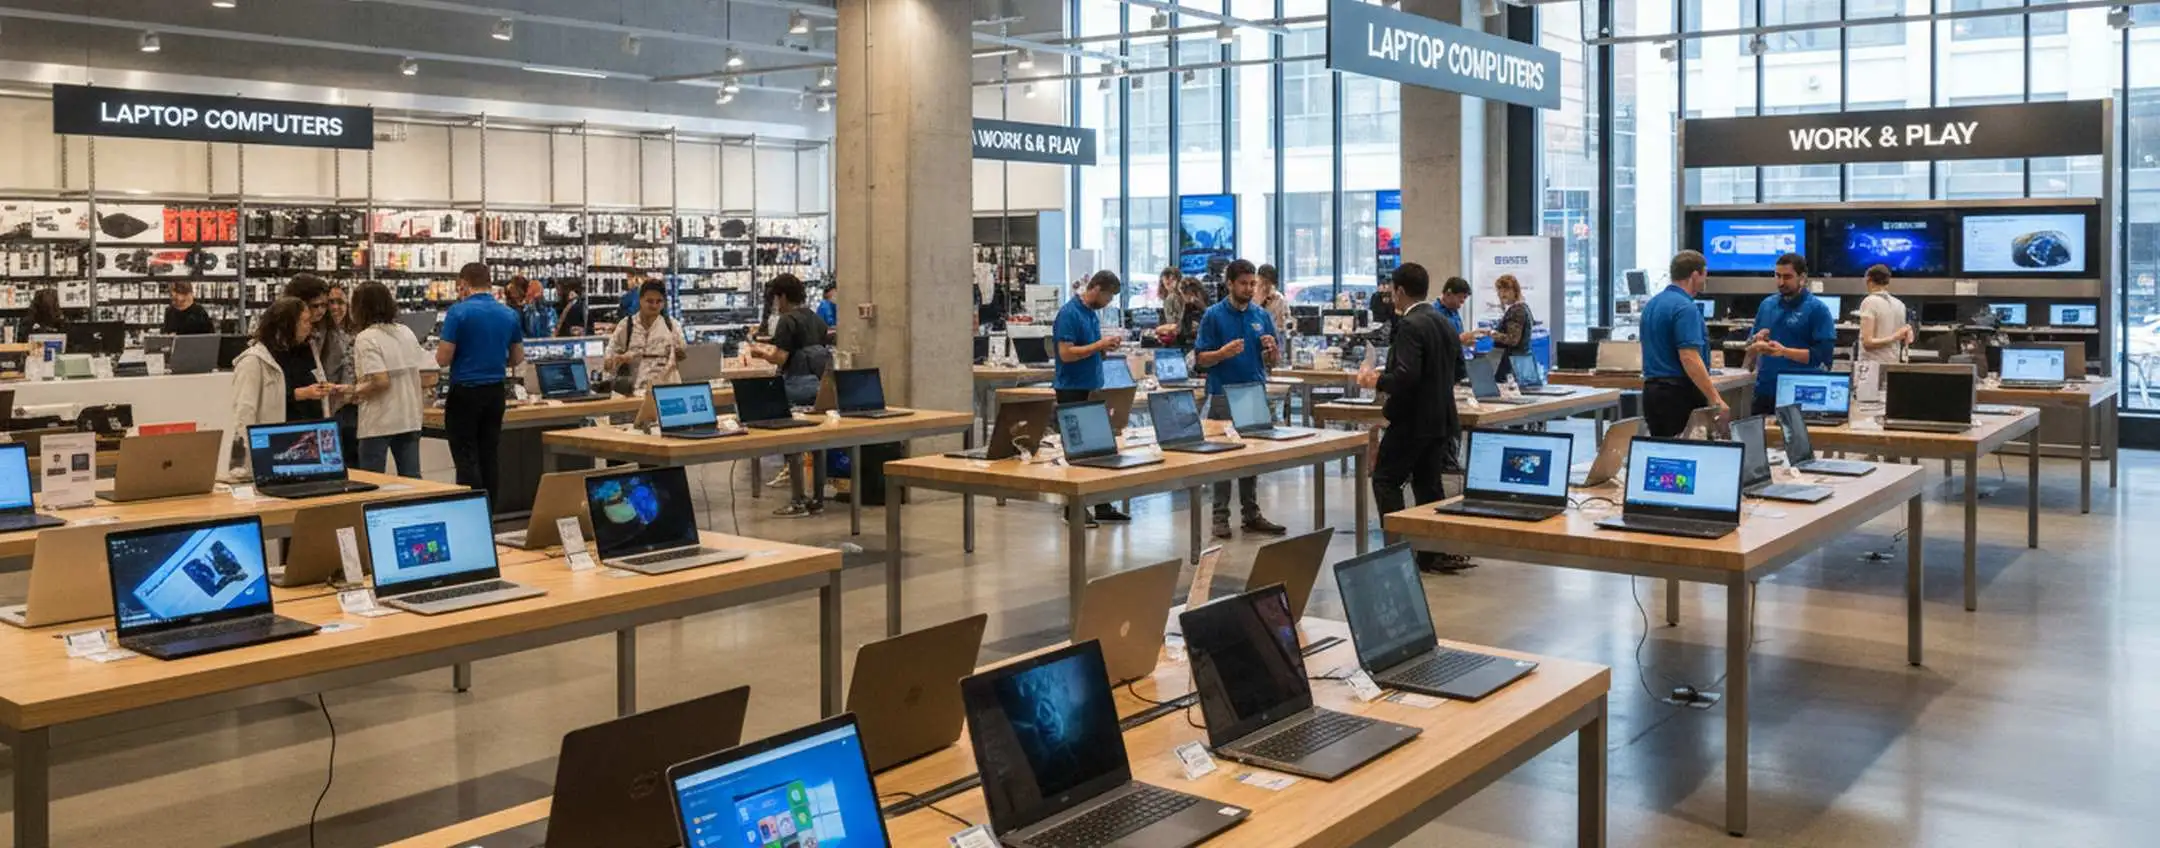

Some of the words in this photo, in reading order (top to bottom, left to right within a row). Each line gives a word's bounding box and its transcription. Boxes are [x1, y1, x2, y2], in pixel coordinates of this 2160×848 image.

[1367, 22, 1445, 69] LAPTOP
[1448, 42, 1544, 92] COMPUTERS
[101, 102, 199, 128] LAPTOP
[204, 109, 344, 136] COMPUTERS
[978, 129, 1023, 150] WORK
[1048, 134, 1082, 156] PLAY
[1789, 126, 1873, 151] WORK
[1878, 125, 1899, 148] &
[1905, 121, 1979, 146] PLAY
